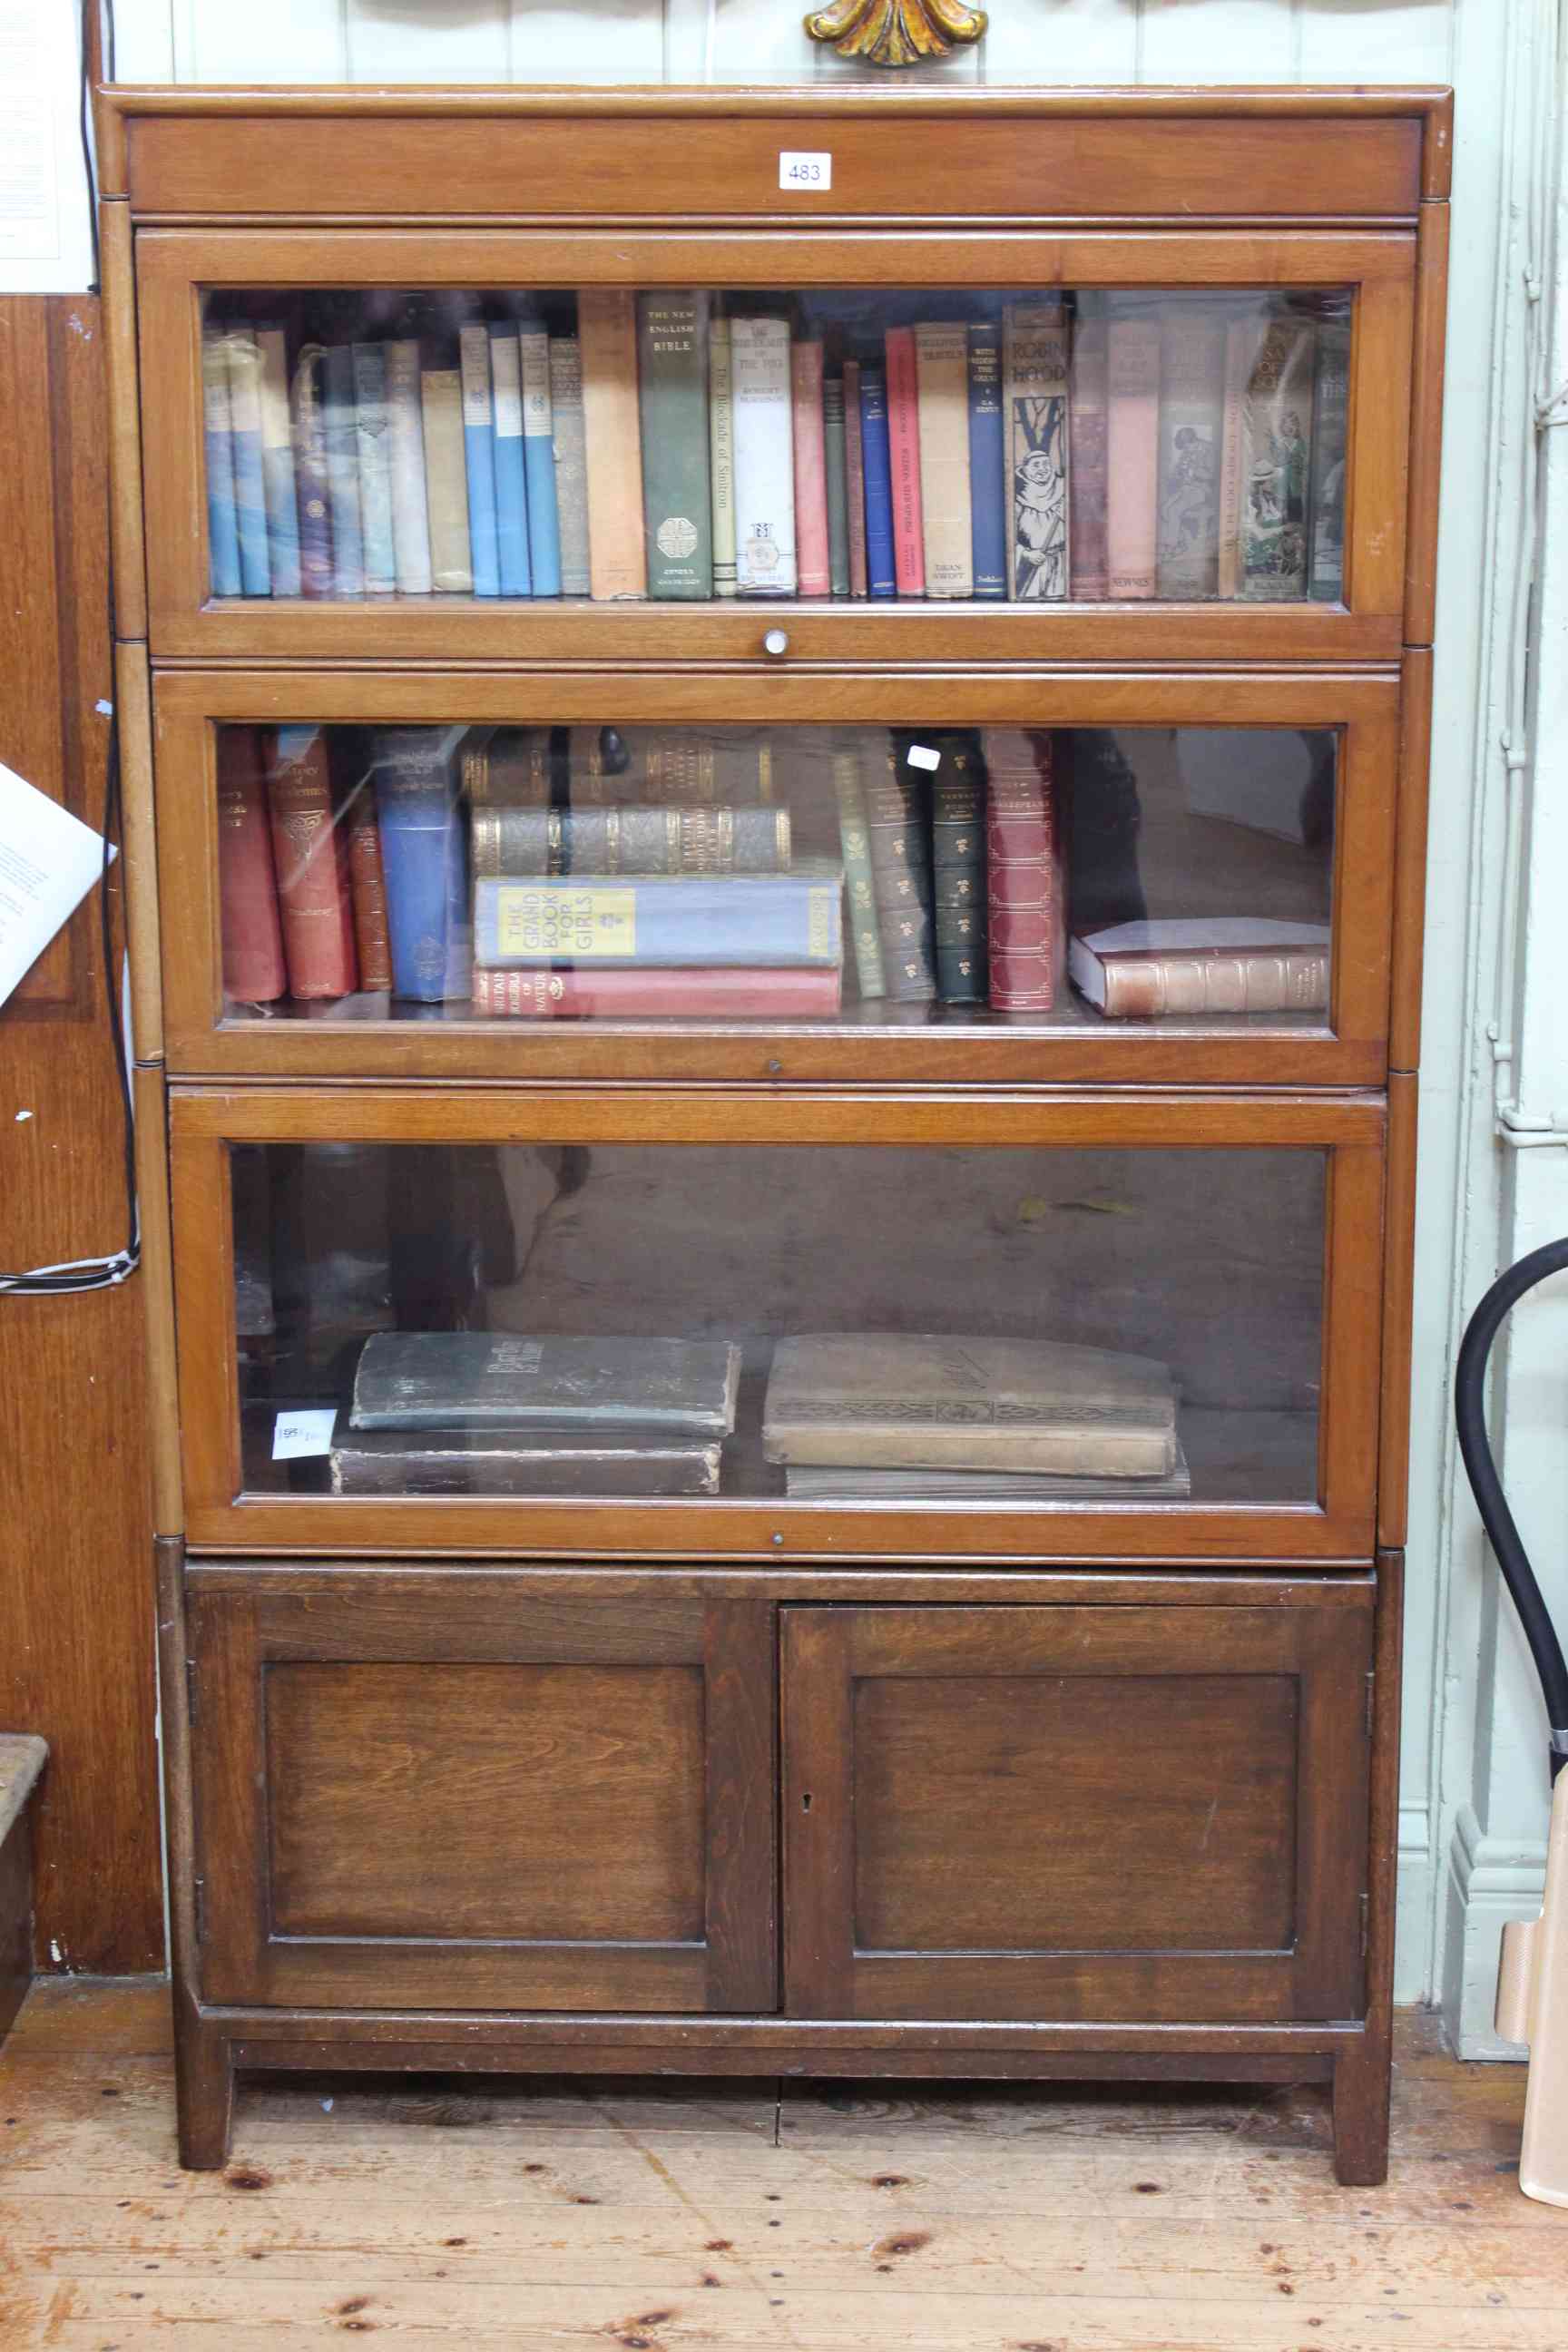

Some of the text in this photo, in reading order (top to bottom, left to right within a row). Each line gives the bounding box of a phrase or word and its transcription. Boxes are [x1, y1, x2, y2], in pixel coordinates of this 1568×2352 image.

[789, 164, 821, 181] 483
[647, 311, 669, 319] THE
[649, 325, 695, 334] ENGLISH
[652, 340, 691, 351] BIBLE
[1013, 341, 1062, 358] ROBIN
[1011, 365, 1066, 383] HOOD
[508, 903, 522, 937] THE
[523, 892, 540, 950] GRAND
[542, 893, 559, 949] BOOK
[560, 903, 574, 938] FOR
[575, 895, 594, 950] GIRLS
[535, 973, 547, 1012] NATUR
